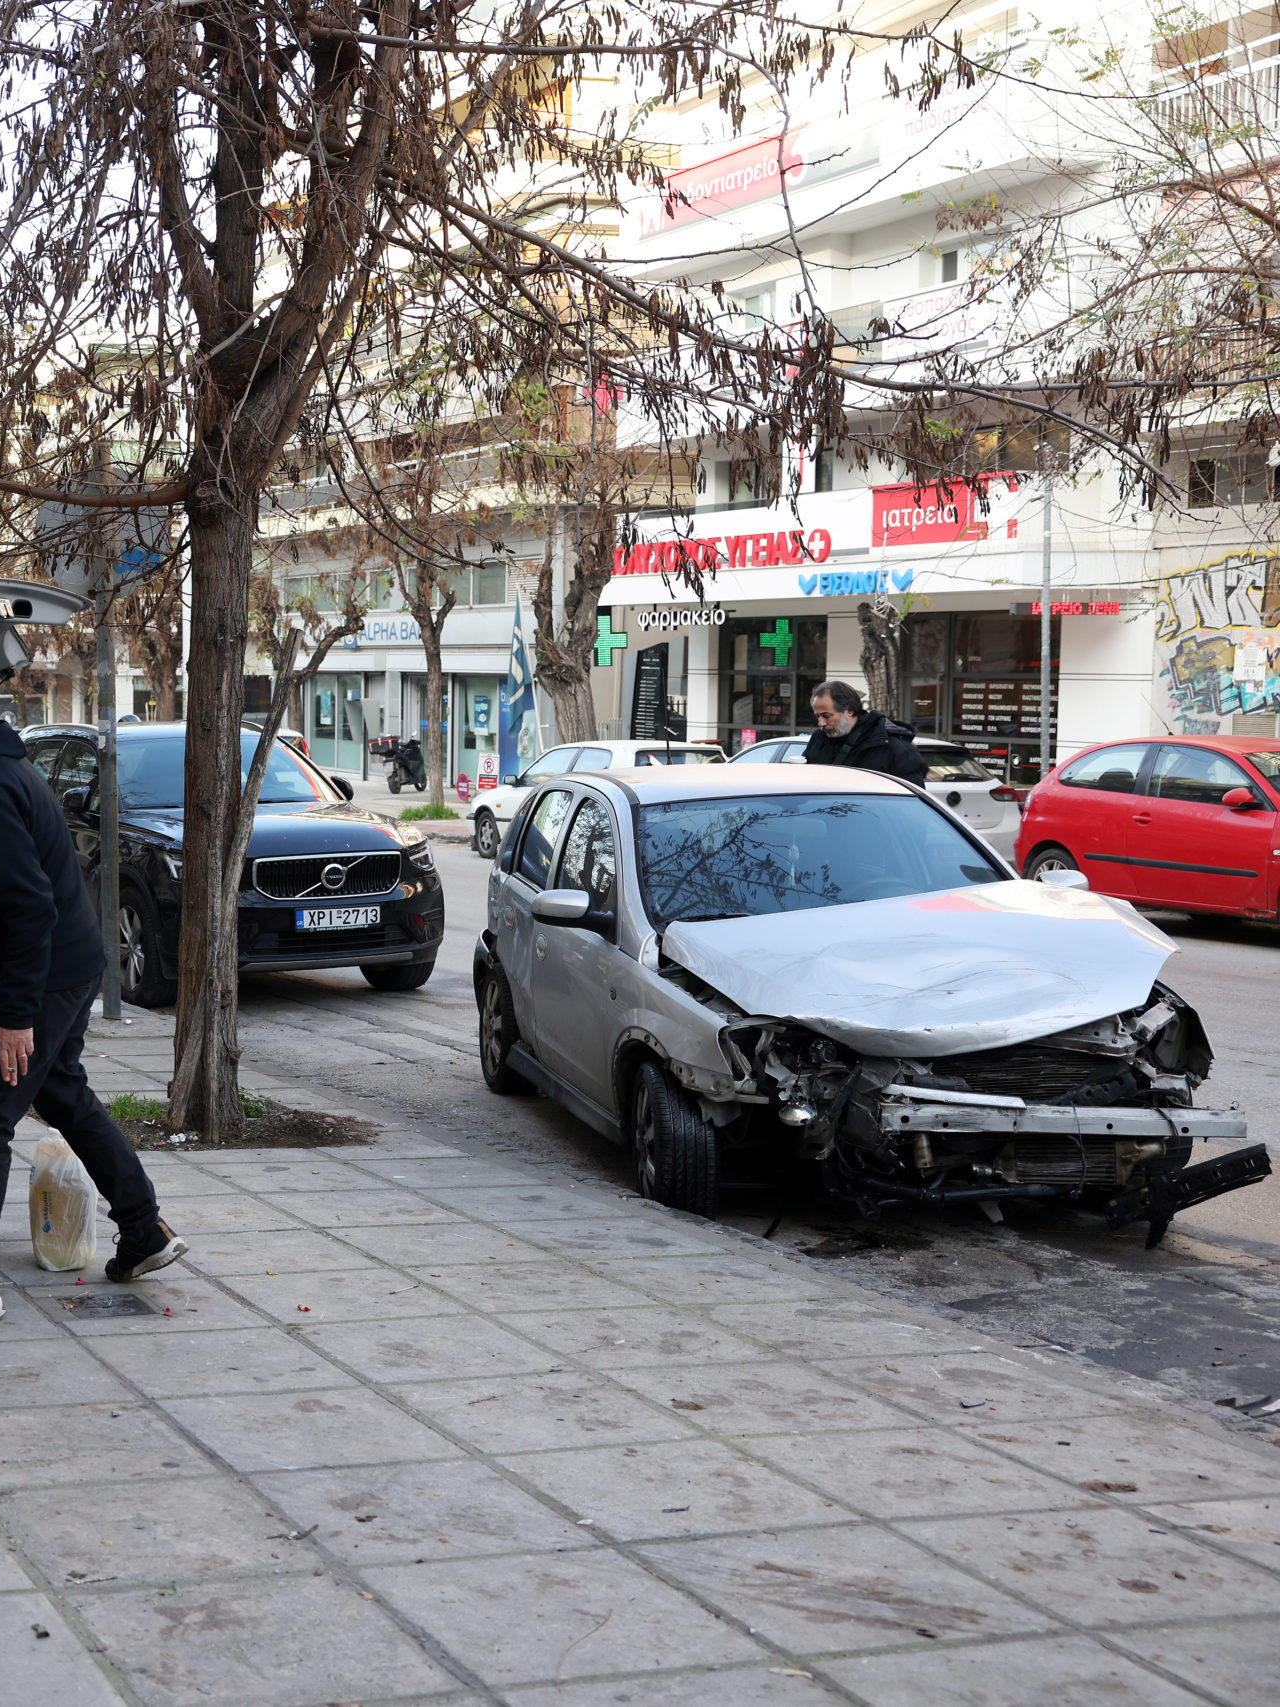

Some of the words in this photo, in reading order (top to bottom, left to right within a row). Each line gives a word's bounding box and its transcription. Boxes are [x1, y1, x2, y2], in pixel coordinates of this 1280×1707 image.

[637, 604, 726, 632] φαρμακείο
[359, 621, 398, 641] ALPHA
[401, 621, 420, 640] BA
